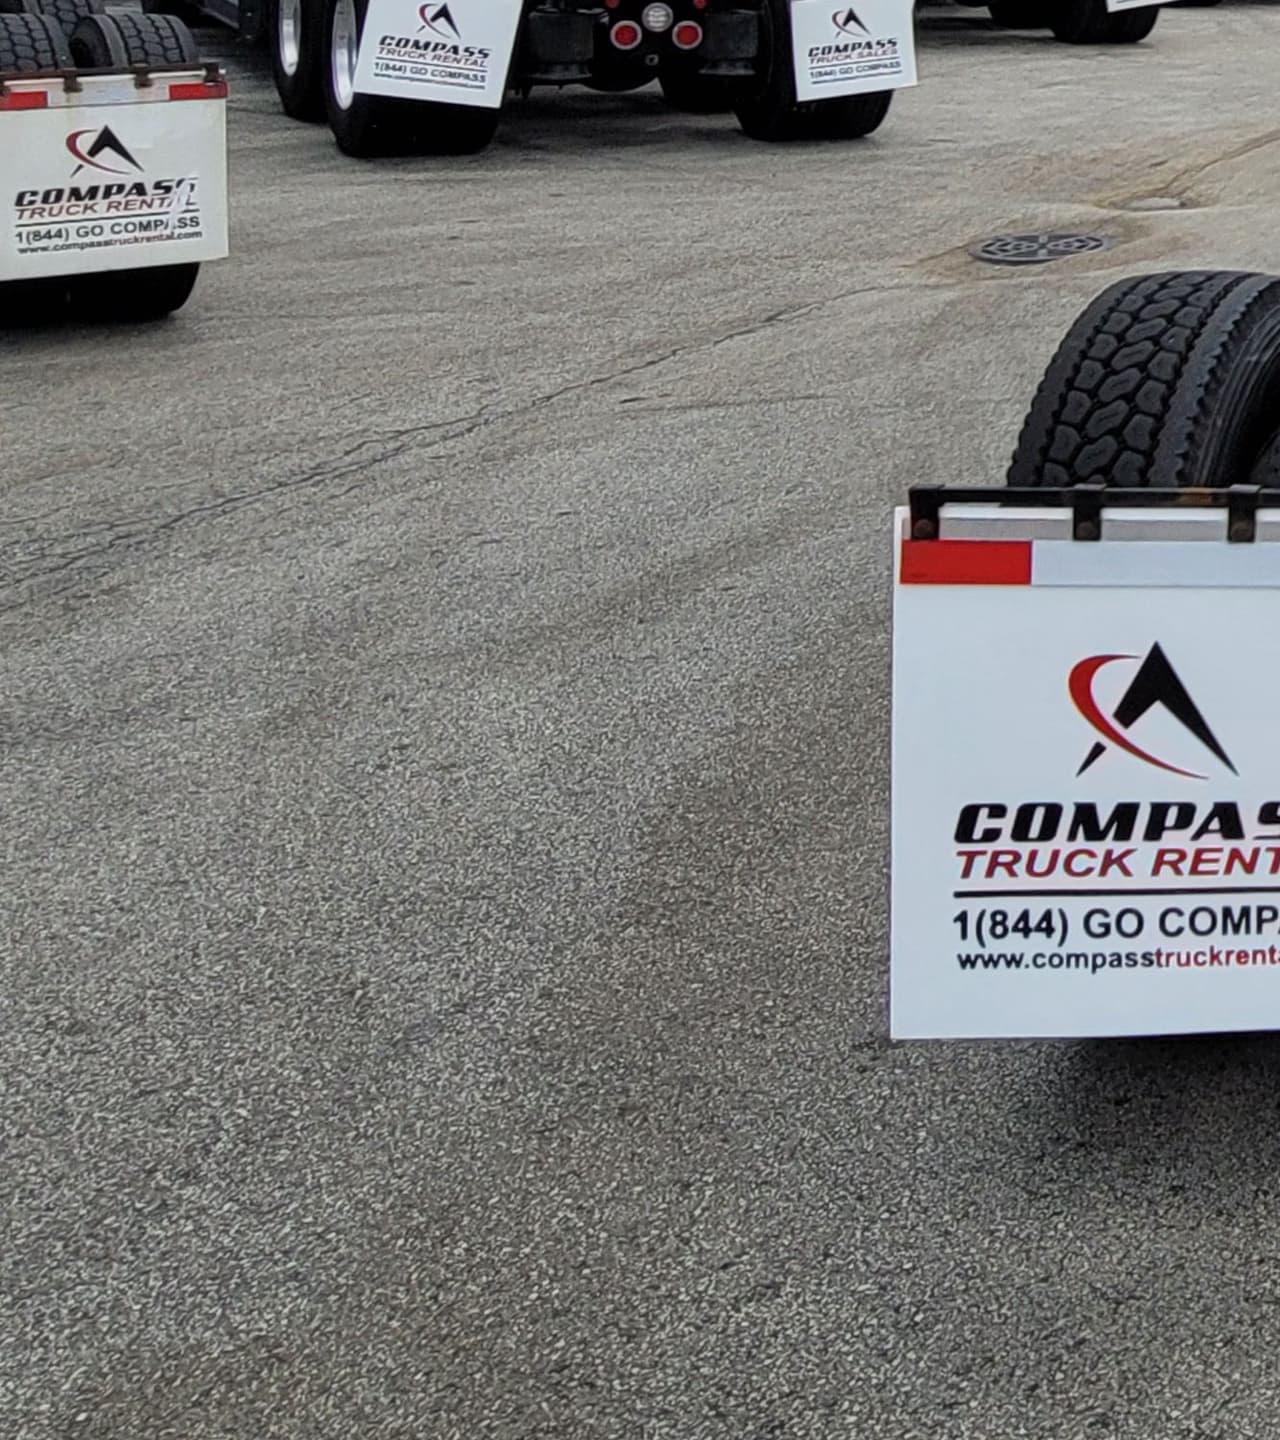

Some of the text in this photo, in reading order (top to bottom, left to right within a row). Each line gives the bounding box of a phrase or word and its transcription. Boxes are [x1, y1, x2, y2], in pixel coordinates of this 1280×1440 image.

[378, 47, 487, 68] TRUCK RENTAL
[379, 35, 493, 59] COMPASS
[808, 38, 898, 58] COMPASS
[409, 67, 429, 77] GO
[430, 69, 487, 83] COMPASS
[15, 196, 197, 220] TRUCK RENTL
[15, 228, 70, 245] 1(844)
[76, 224, 104, 239] GO
[17, 231, 203, 254] www.compasstruckrental.com
[955, 847, 1138, 879] TRUCK
[953, 907, 1069, 948] 1(844)
[1082, 907, 1144, 940] GO
